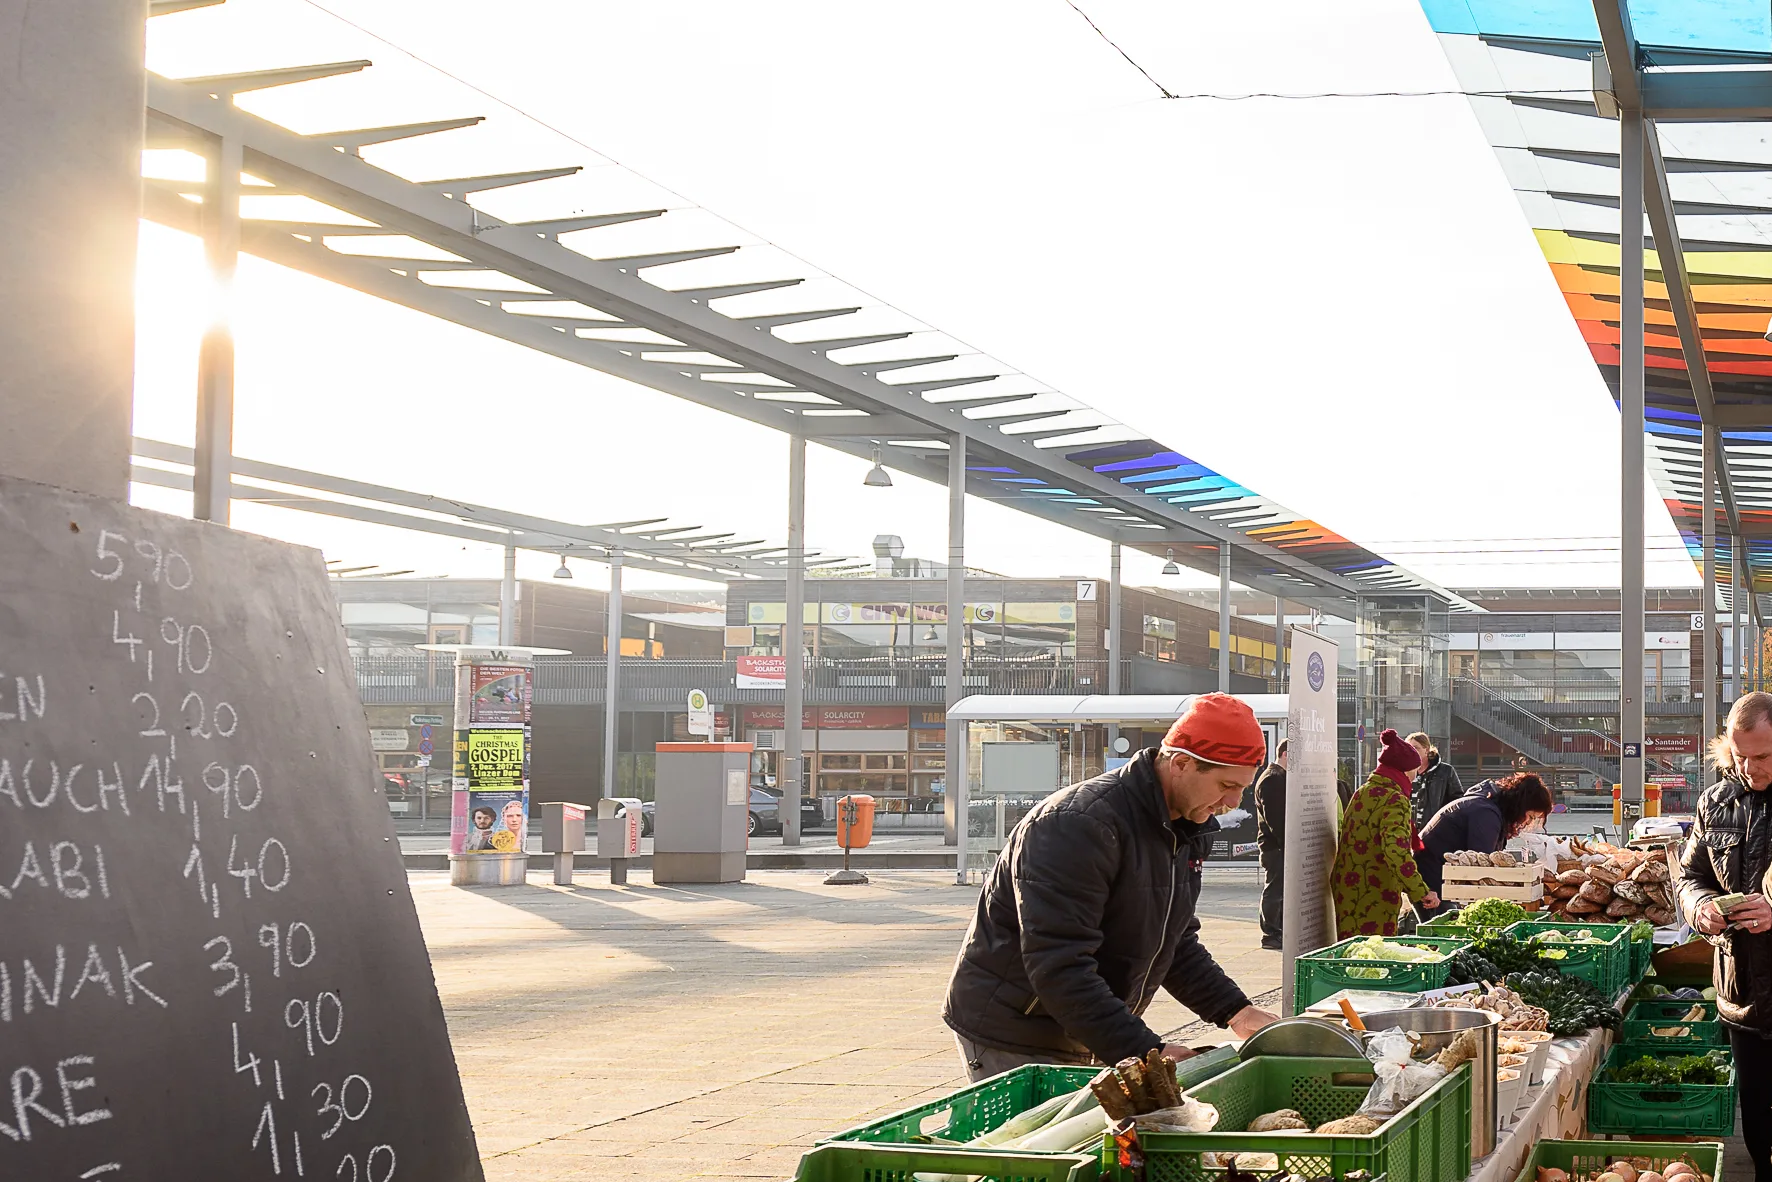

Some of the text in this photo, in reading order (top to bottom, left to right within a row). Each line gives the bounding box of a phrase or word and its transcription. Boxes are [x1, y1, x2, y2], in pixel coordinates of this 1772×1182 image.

[860, 604, 910, 621] CITY
[1081, 583, 1092, 599] 7
[1694, 615, 1704, 629] 8
[112, 609, 213, 682] 4,90
[131, 690, 238, 761] 2,20
[823, 711, 866, 719] SOLARCITY
[471, 748, 522, 763] GOSPEL
[1654, 738, 1691, 746] Santander
[470, 763, 478, 771] 2.
[479, 763, 495, 771] Dez.
[496, 763, 514, 771] 2017
[138, 753, 263, 841] 14,90
[183, 833, 292, 919] 1,40
[203, 920, 317, 1012] 3,90
[232, 990, 345, 1100] 4,90
[251, 1073, 373, 1177] 1,30
